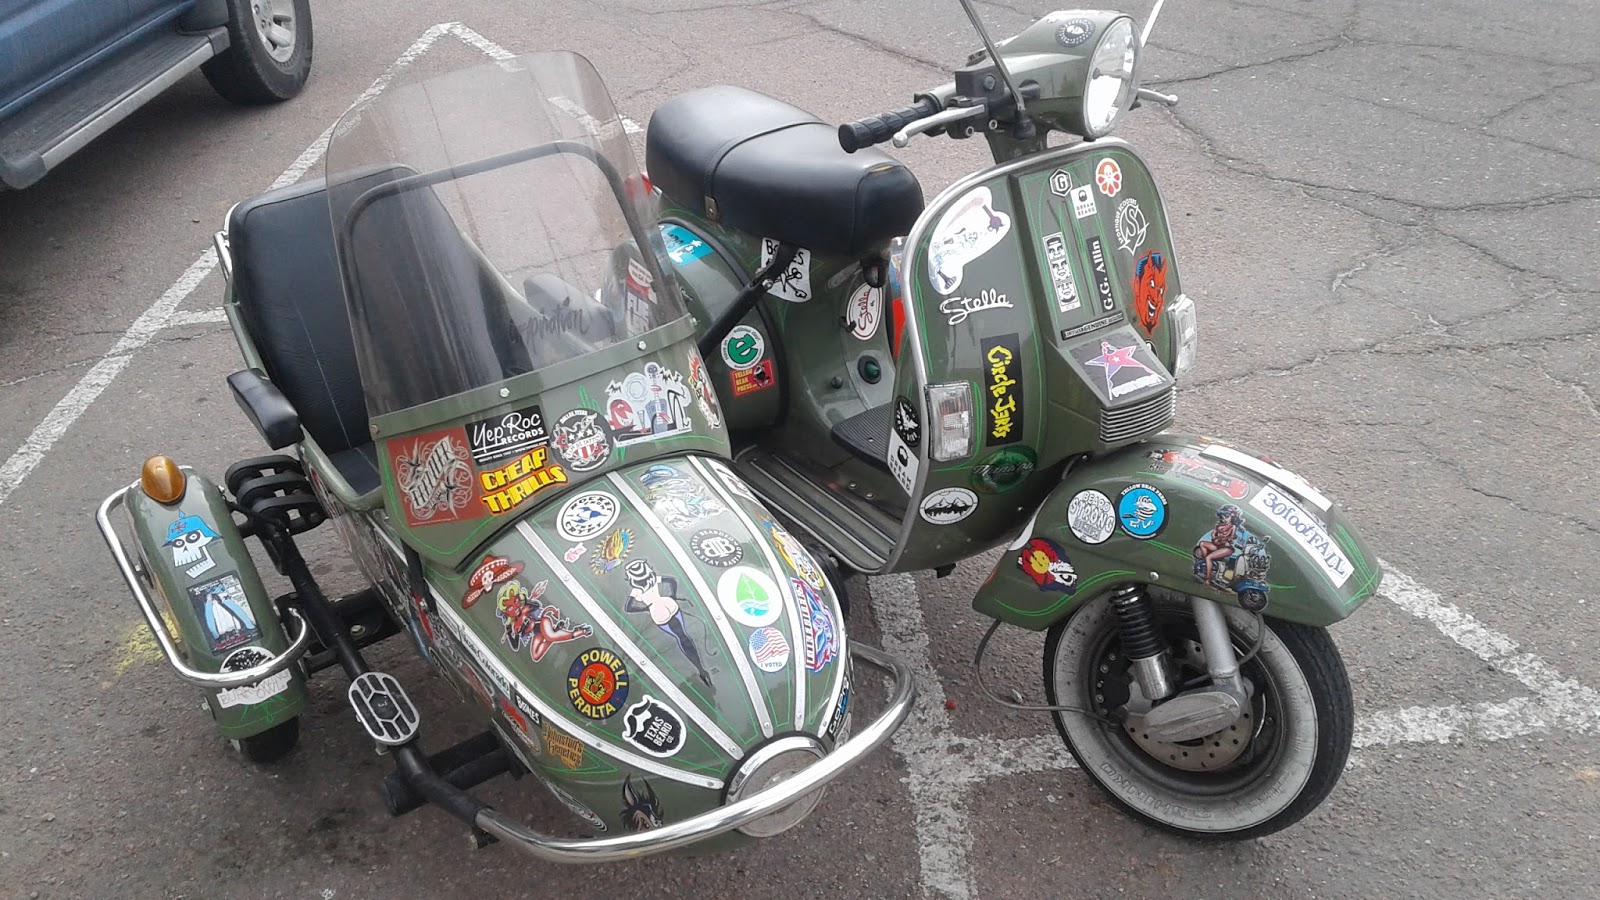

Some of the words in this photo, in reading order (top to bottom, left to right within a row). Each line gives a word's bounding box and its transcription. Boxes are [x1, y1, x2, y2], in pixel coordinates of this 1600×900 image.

[1077, 207, 1095, 216] BEARD
[1091, 241, 1109, 275] Allin
[939, 288, 1013, 325] Stella
[1100, 276, 1115, 310] G.G.
[501, 427, 544, 446] RECORDS
[481, 448, 546, 491] CHEAP
[482, 465, 567, 512] THRILLS
[570, 497, 612, 512] ROCKET
[1083, 491, 1110, 512] BEARD
[1070, 498, 1114, 533] STRONG
[699, 530, 734, 543] BEARDED
[581, 650, 627, 690] POWELL
[569, 678, 616, 717] PERALTA
[644, 716, 664, 741] TEXAS
[653, 722, 672, 746] BEARD
